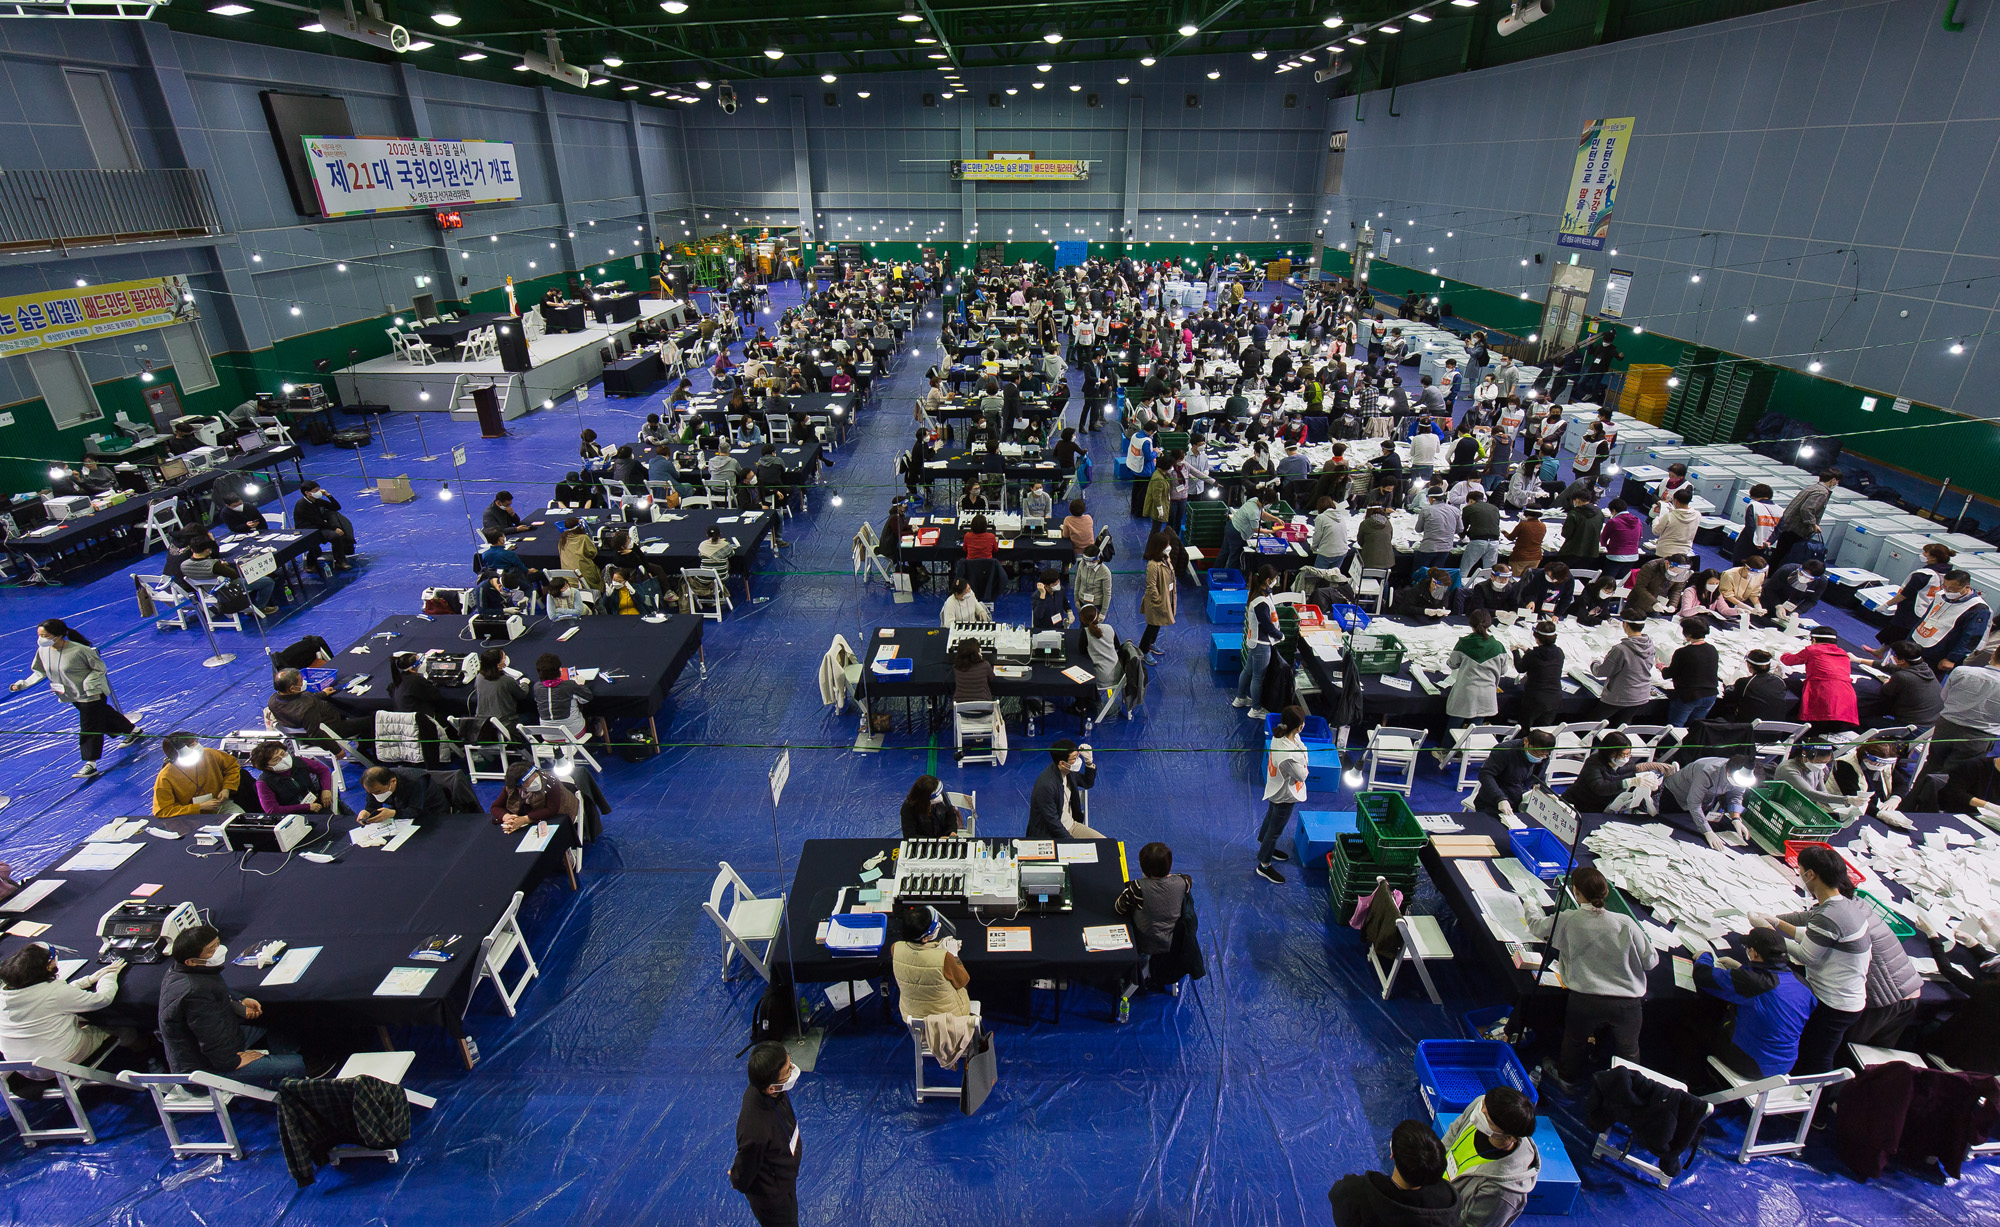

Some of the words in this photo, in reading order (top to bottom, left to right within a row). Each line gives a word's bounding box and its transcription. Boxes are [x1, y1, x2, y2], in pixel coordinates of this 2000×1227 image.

[386, 142, 418, 156] 2020년
[419, 143, 432, 156] 4월
[434, 143, 451, 156] 15일
[452, 143, 467, 157] 실시
[961, 163, 983, 173] 배드민턴
[984, 163, 1005, 173] 고수되는
[1006, 163, 1017, 173] 숨은
[1034, 163, 1056, 173] 배드민턴
[1056, 163, 1078, 173] 필라테스
[1582, 137, 1601, 183] 민턴으로
[1596, 138, 1616, 183] 민턴으로
[326, 158, 394, 193] 제21대
[396, 158, 487, 189] 국회의원선거
[488, 160, 514, 184] 개표
[1575, 188, 1589, 221] 땀을!
[1587, 188, 1604, 233] 건강을!
[17, 303, 48, 332] 숨은
[45, 298, 84, 326] 비결!!
[81, 290, 132, 320] 배드민턴
[128, 286, 174, 313] 필라테스
